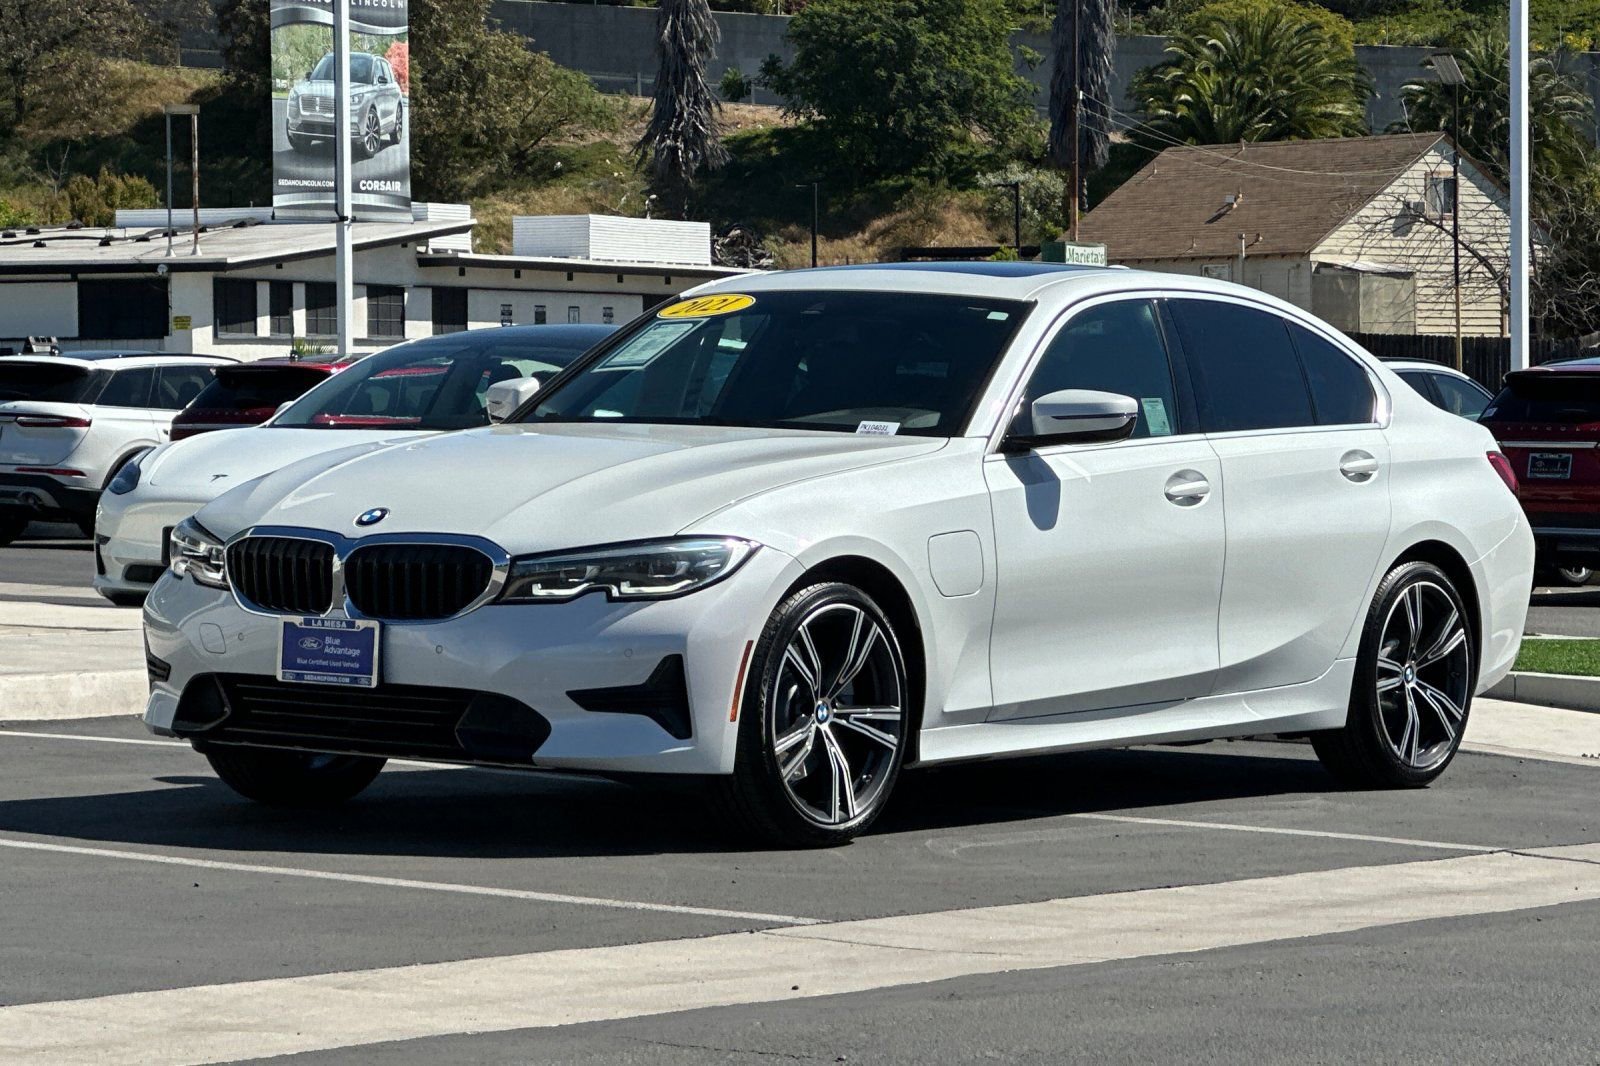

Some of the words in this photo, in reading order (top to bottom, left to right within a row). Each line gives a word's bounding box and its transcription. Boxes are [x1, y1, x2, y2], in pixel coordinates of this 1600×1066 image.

[351, 0, 403, 8] LINCOLN
[359, 180, 401, 191] CORSAIR
[1067, 248, 1105, 264] Marieta's
[668, 298, 743, 315] 2021
[311, 619, 322, 627] LA
[324, 620, 347, 628] MESA
[325, 636, 341, 645] Blue
[324, 646, 361, 657] Advantage
